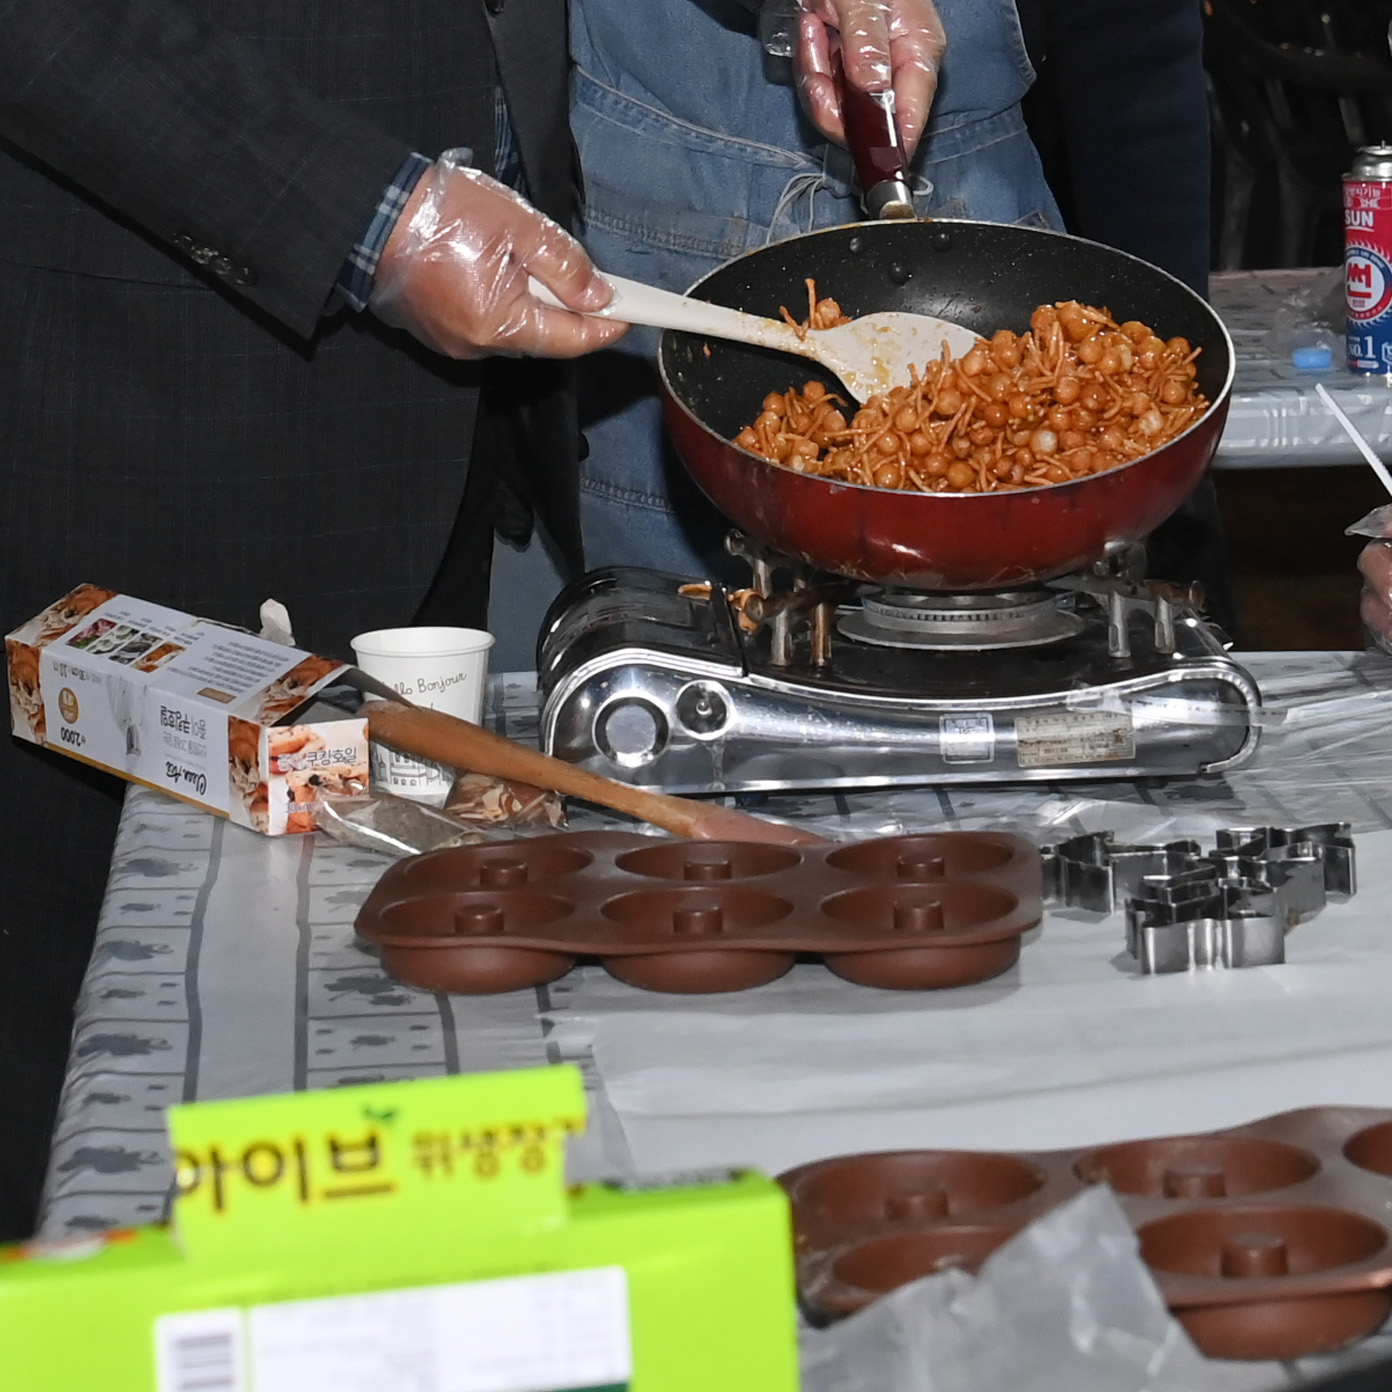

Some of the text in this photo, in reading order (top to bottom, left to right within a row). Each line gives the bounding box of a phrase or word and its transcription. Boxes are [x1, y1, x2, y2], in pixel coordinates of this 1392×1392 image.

[1345, 210, 1374, 227] SUN
[416, 672, 468, 694] Bonjour
[160, 704, 191, 735] 쿠킹호일
[306, 745, 358, 767] 쿠킹호일
[182, 768, 207, 796] Clean
